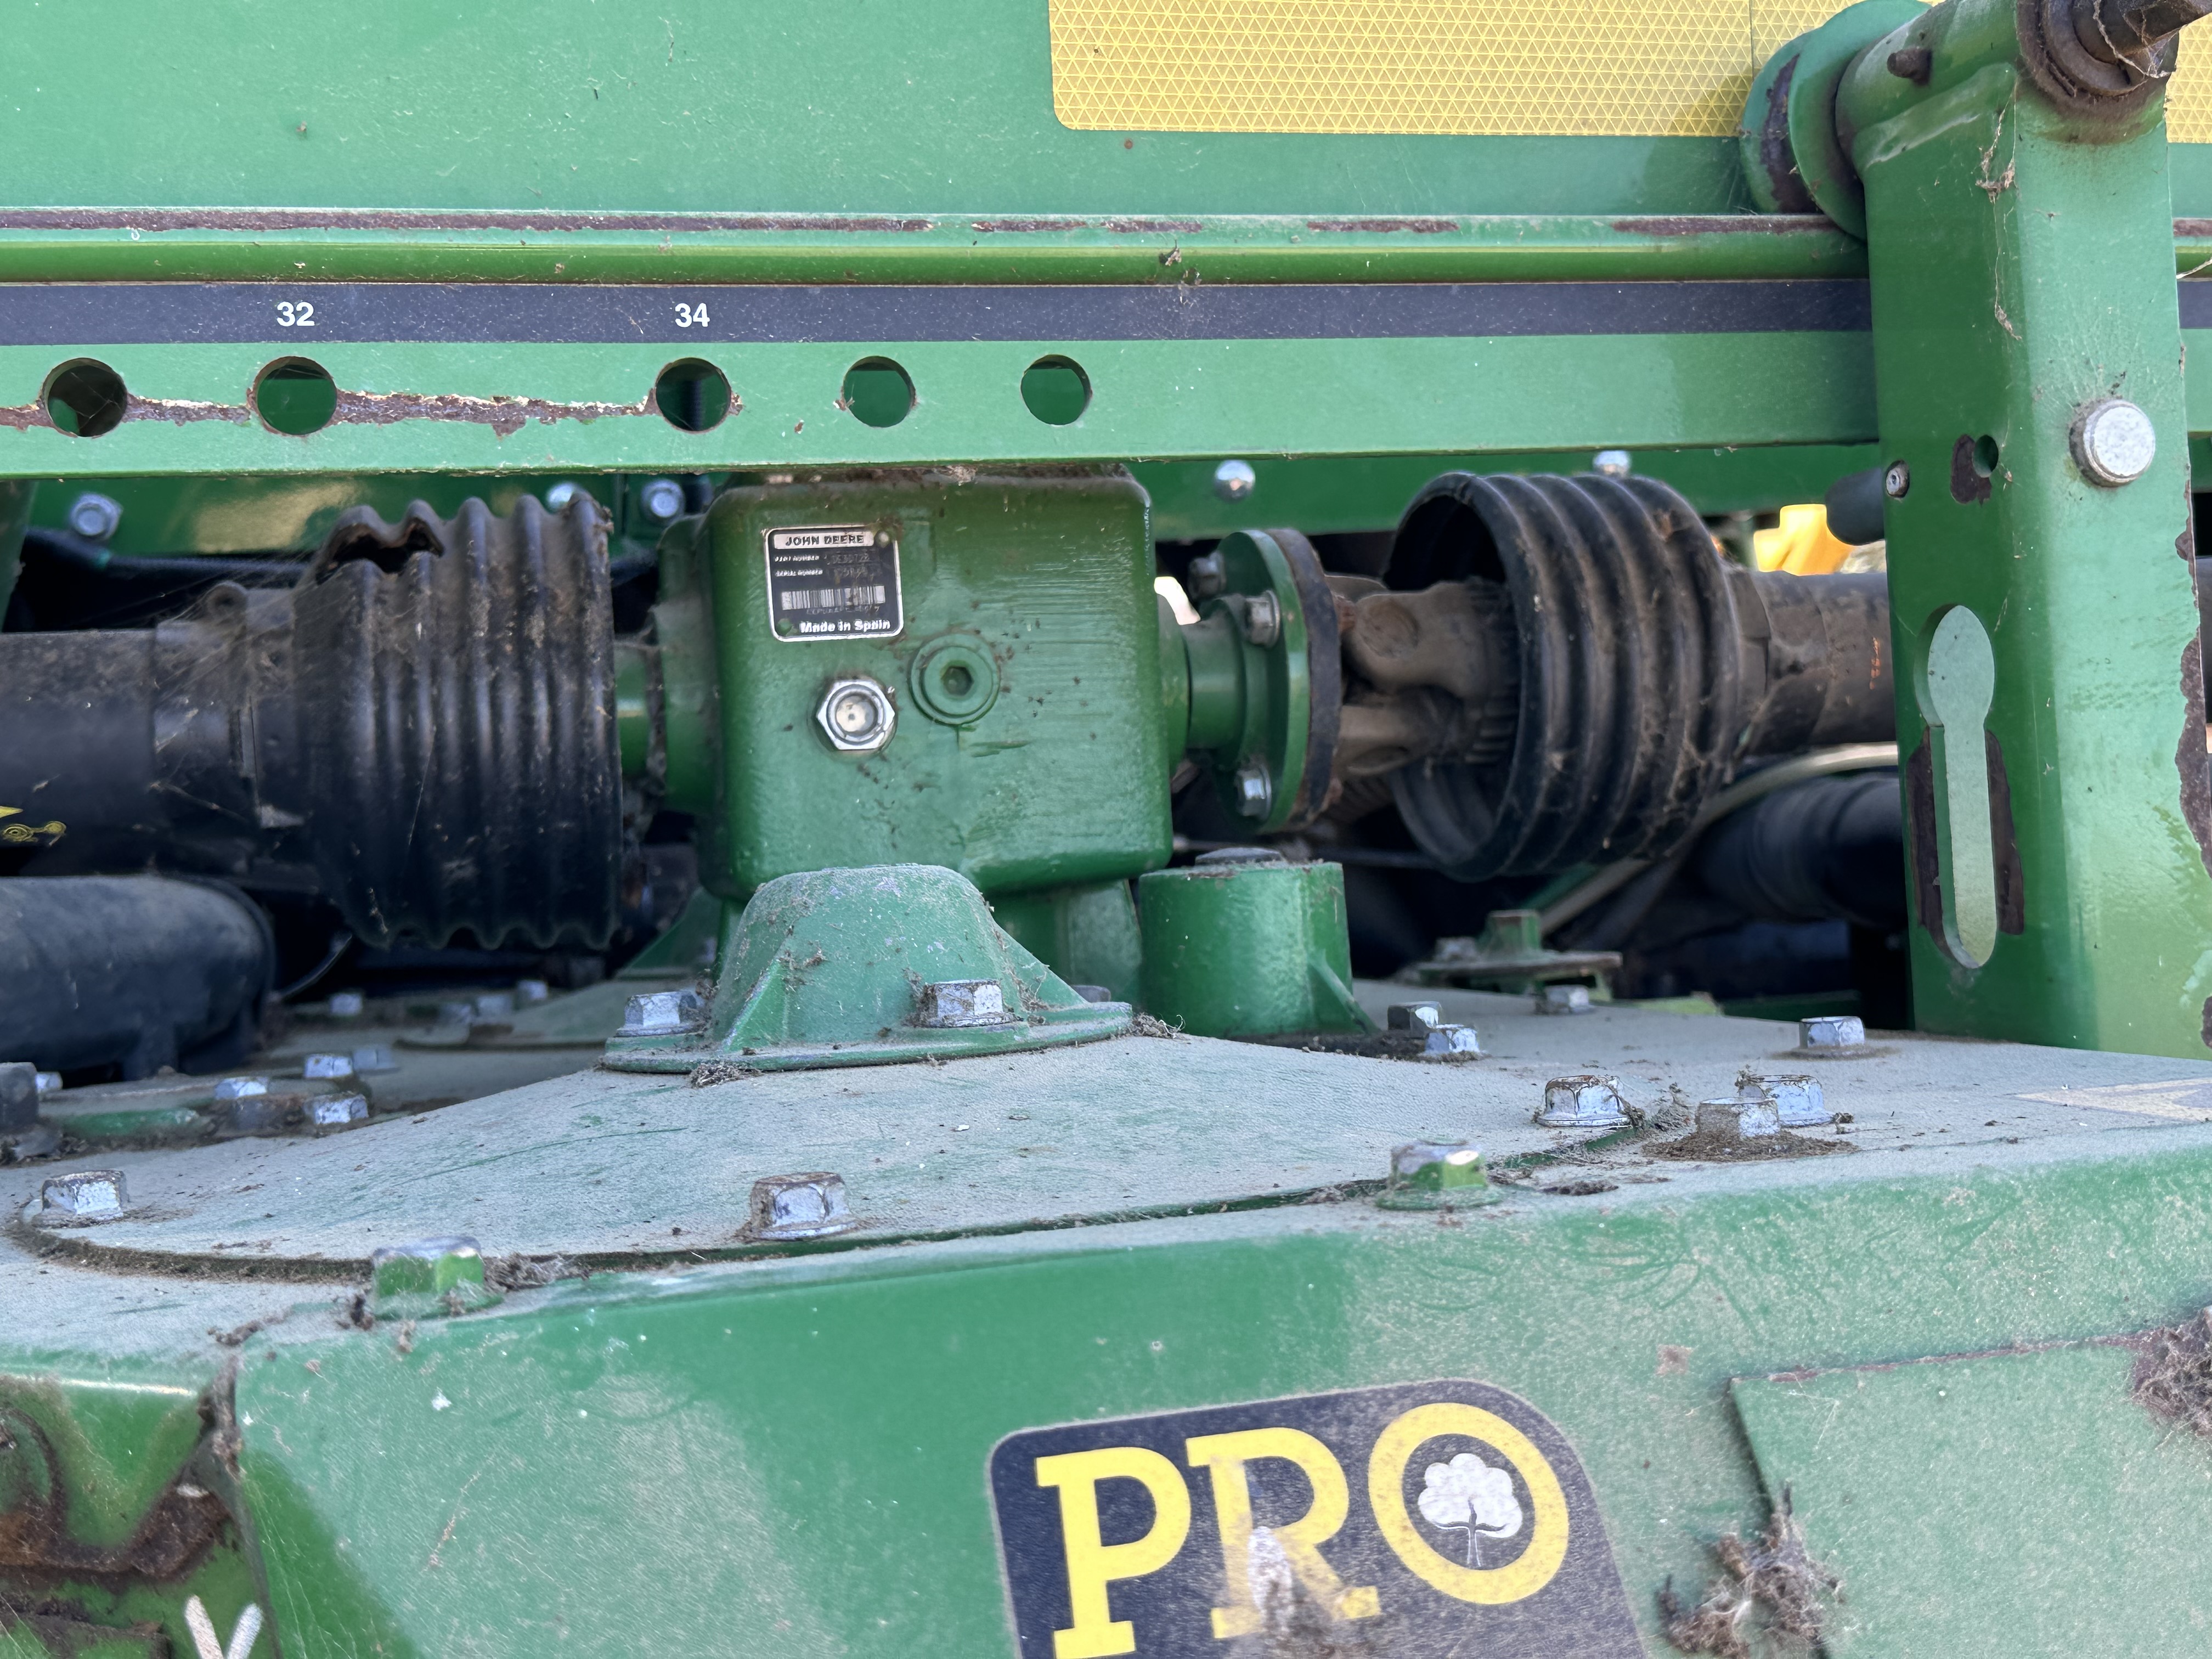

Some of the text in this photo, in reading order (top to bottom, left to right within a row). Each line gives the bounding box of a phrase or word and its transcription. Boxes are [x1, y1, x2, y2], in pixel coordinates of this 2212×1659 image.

[276, 301, 315, 328] 32
[674, 302, 710, 328] 34
[785, 534, 865, 546] JOHN DEERE
[799, 618, 891, 633] Made in Spain
[1035, 1402, 1569, 1658] PRO
